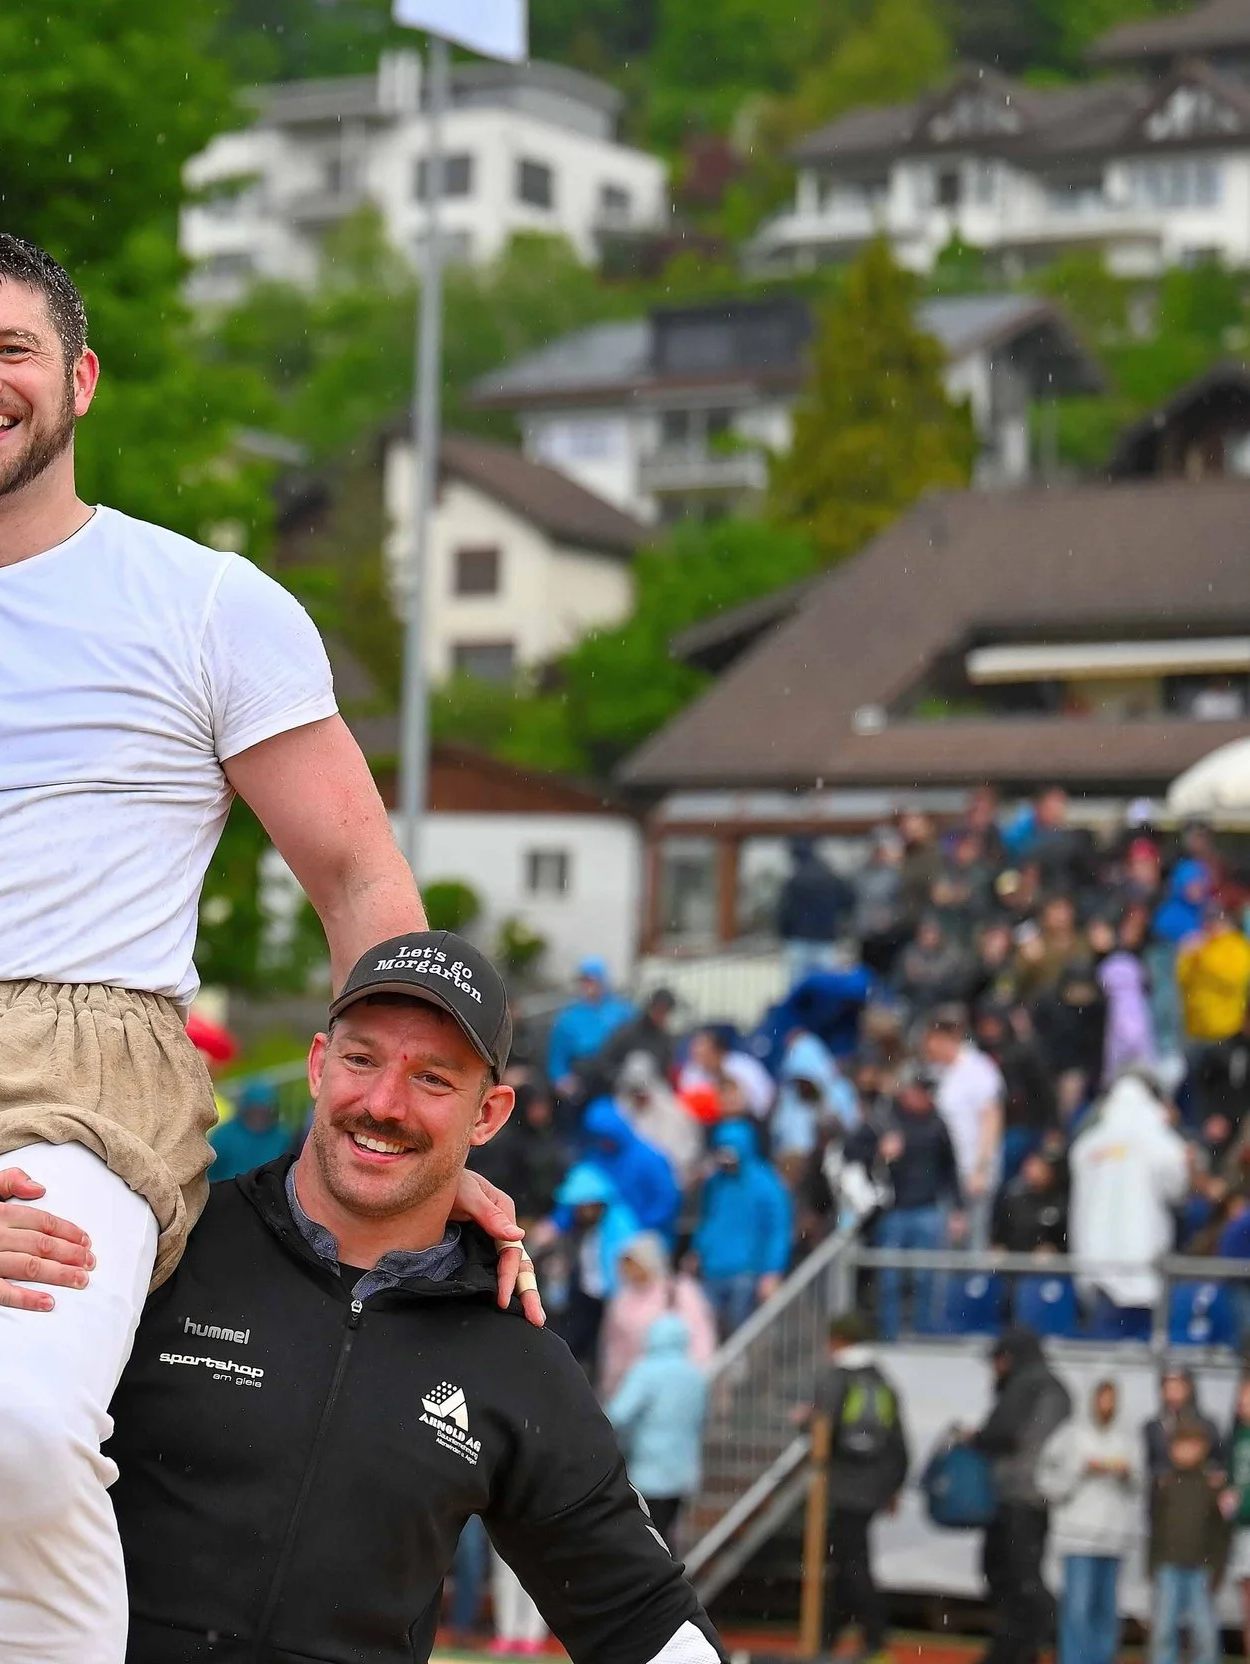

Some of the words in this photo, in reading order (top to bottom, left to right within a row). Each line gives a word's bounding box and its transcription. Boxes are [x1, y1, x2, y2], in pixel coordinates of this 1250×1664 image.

[395, 946, 447, 962] Let's
[450, 961, 472, 979] go
[373, 959, 482, 1003] Morgarten
[183, 1317, 250, 1345] hummel
[159, 1352, 264, 1378] sportshop
[213, 1373, 231, 1381] am
[235, 1377, 262, 1388] gleis
[418, 1412, 466, 1442] ARNOLD
[465, 1436, 481, 1452] AG
